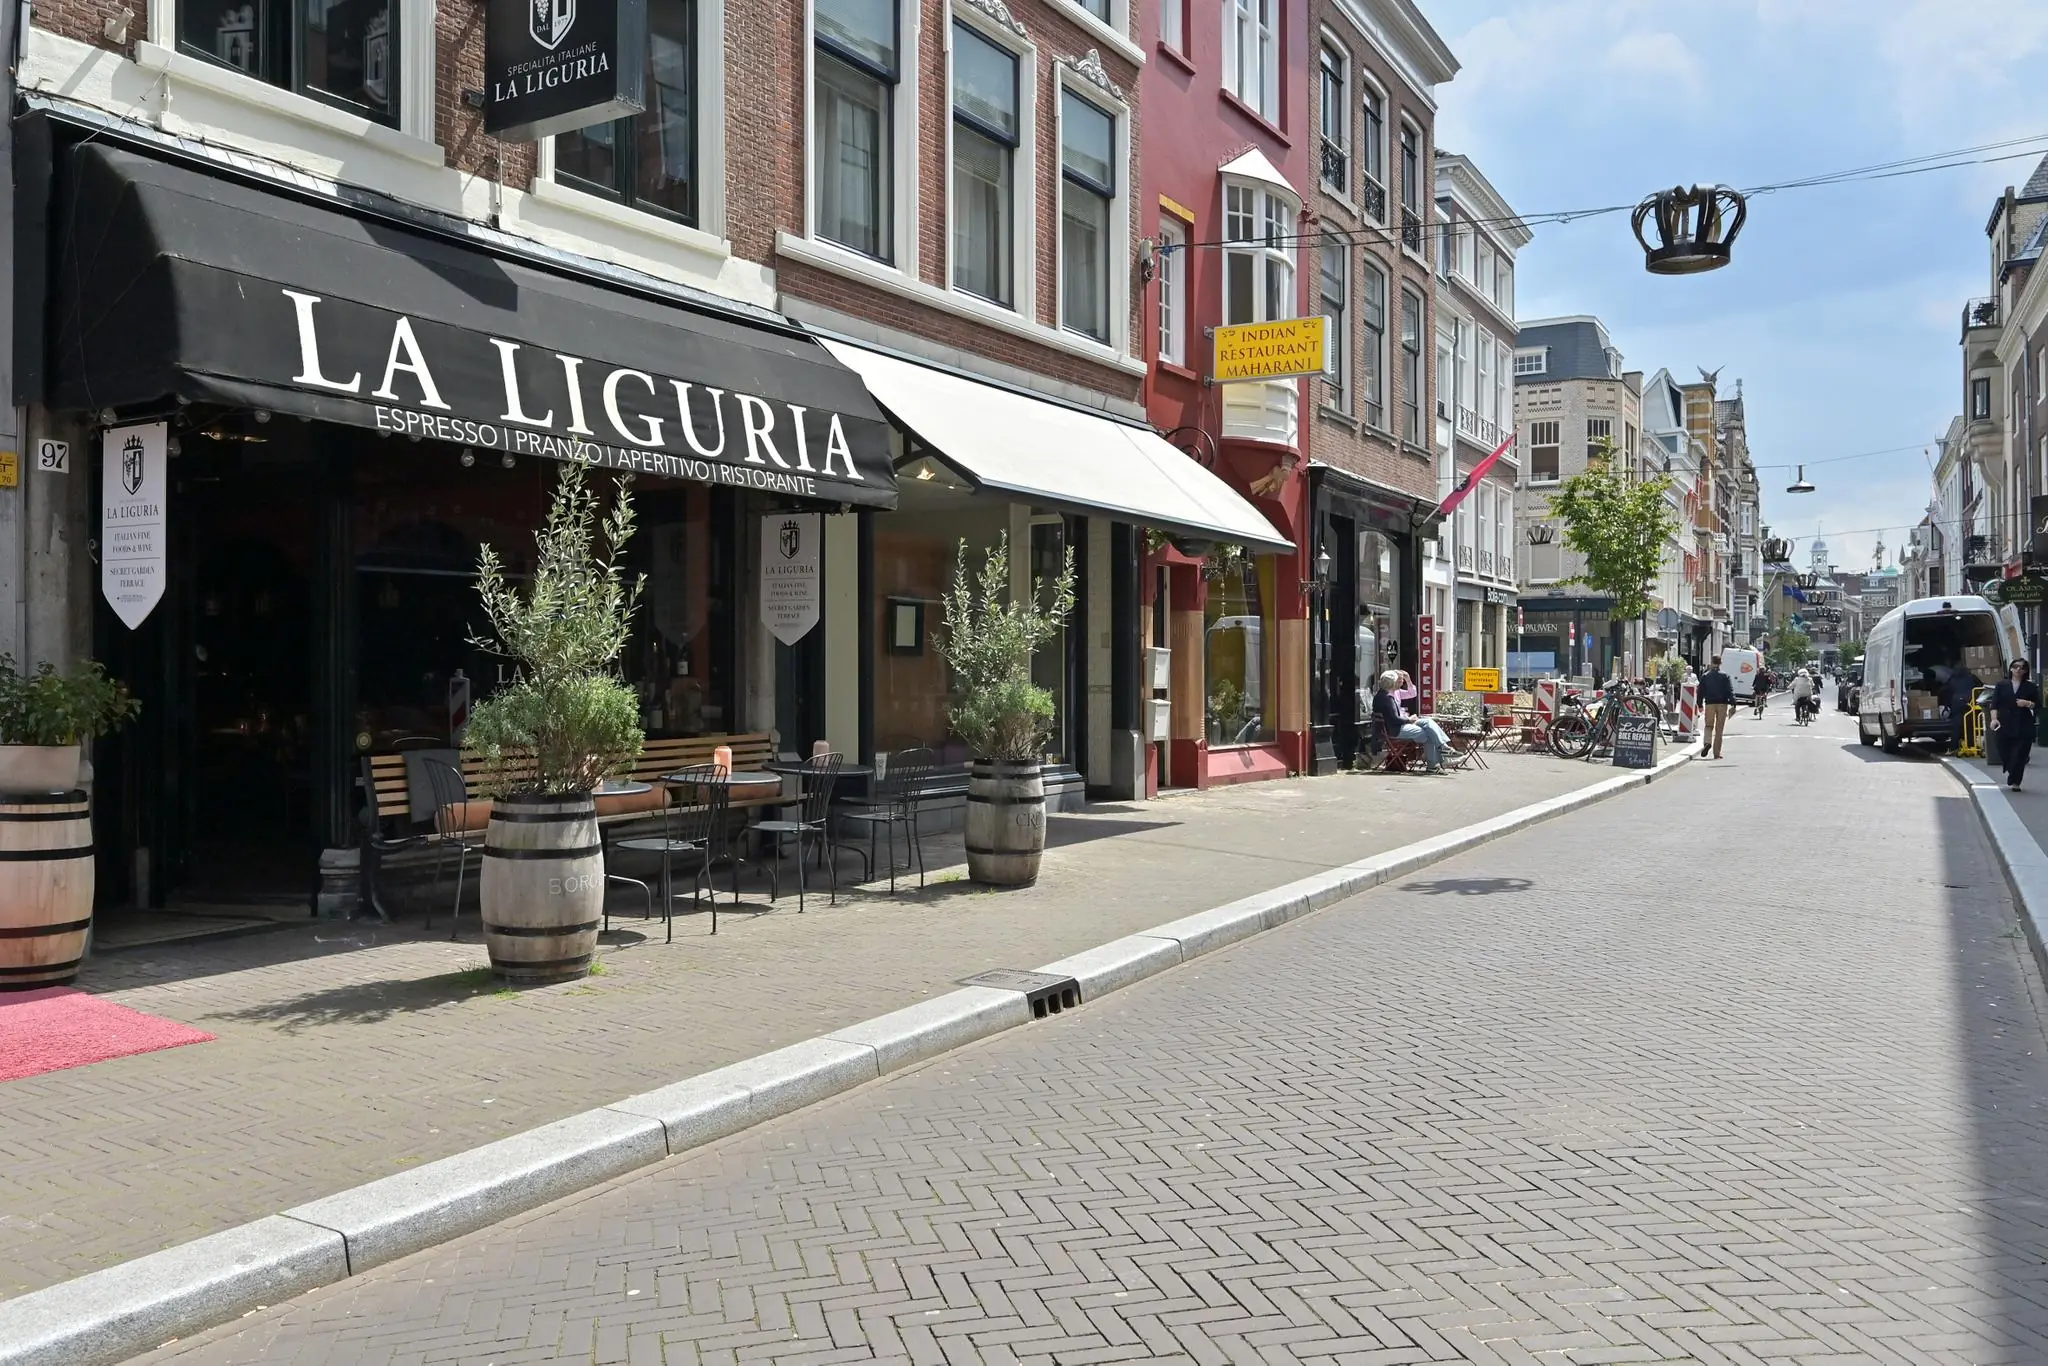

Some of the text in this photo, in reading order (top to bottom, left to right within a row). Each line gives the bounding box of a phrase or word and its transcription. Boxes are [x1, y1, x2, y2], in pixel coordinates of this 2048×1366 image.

[536, 24, 550, 33] DAL
[507, 41, 597, 77] SPECIALITA ITALIANE
[494, 52, 609, 103] LA LIGURIA
[1242, 326, 1296, 343] INDIAN
[1220, 340, 1318, 361] RESTAURANT
[1226, 357, 1312, 377] MAHARANI
[281, 289, 865, 480] LA LIGURIA
[41, 442, 67, 469] 97
[374, 405, 817, 496] ESPRESSO PRANZO APERITIVO RISTORANTE
[107, 504, 159, 520] LA LIGURIA
[765, 565, 814, 575] LA LIGURIA
[1525, 623, 1558, 632] PAUWEN
[1421, 623, 1431, 698] COFFEE
[1618, 732, 1652, 741] BIKE REPAIR
